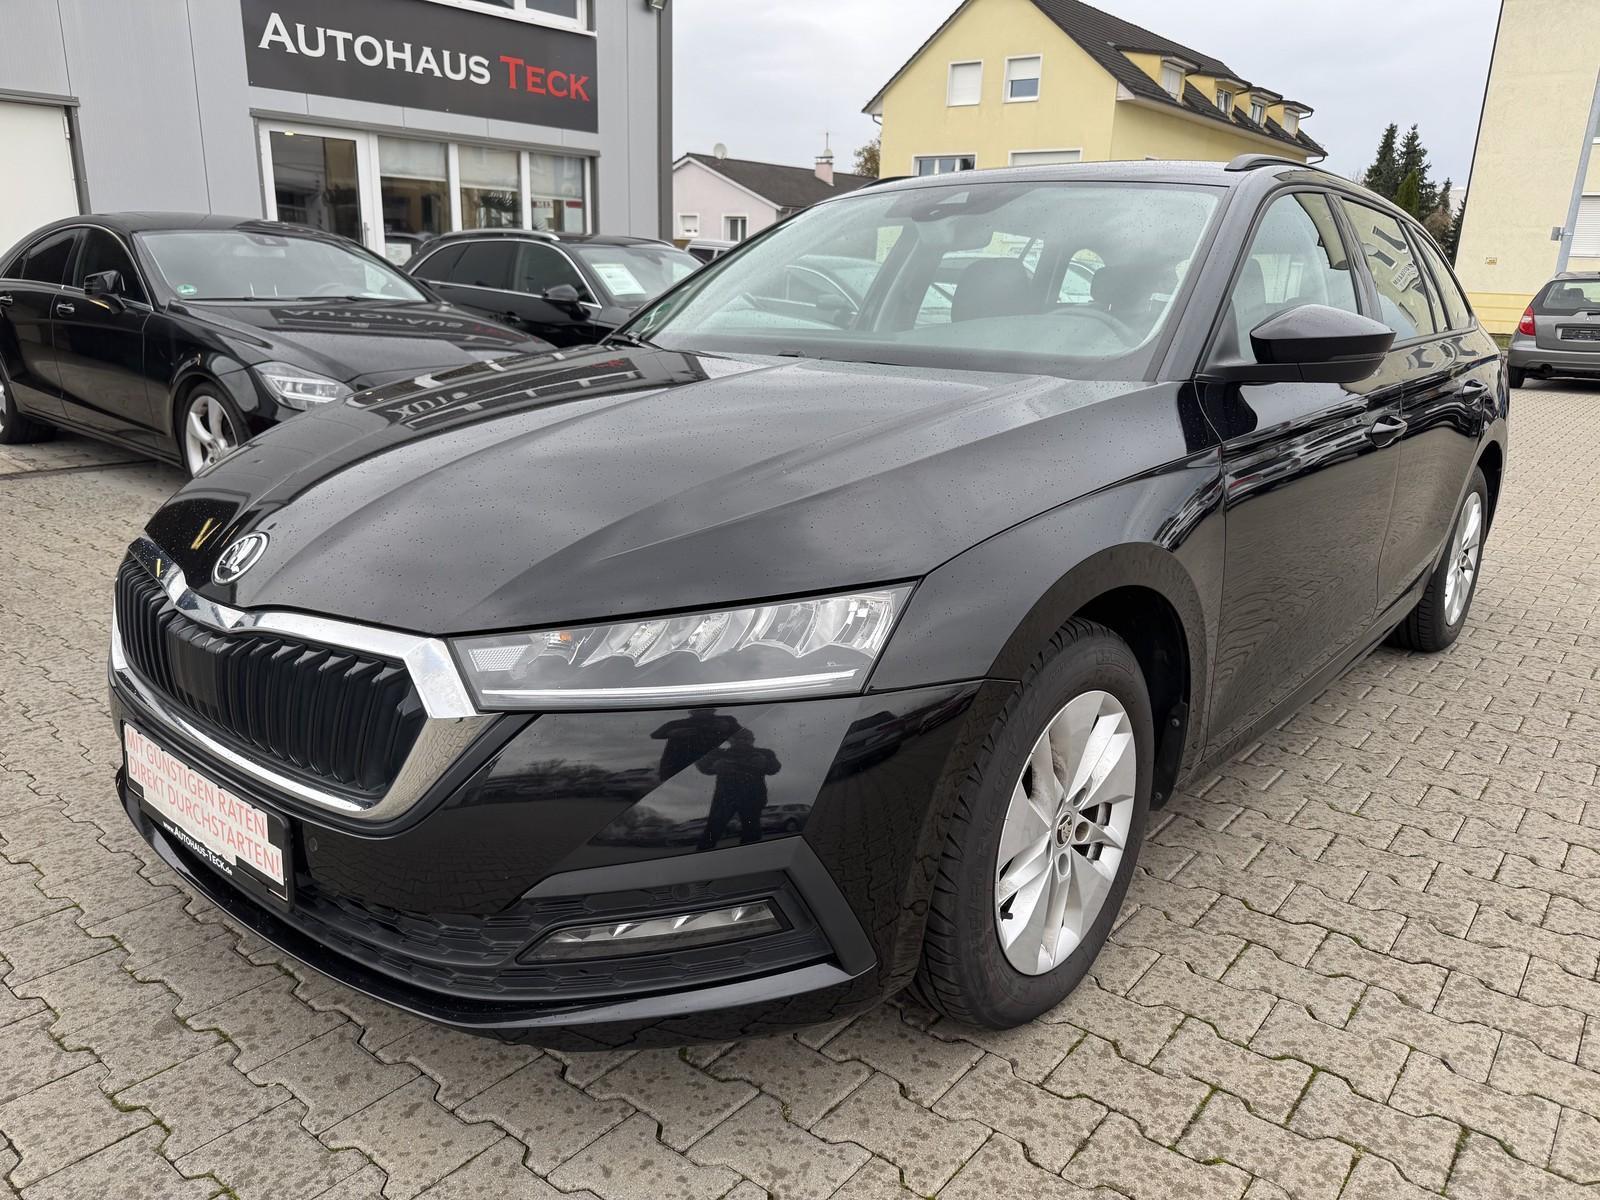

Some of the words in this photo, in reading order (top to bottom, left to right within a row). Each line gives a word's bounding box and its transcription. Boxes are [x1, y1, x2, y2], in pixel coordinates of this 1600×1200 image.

[258, 12, 491, 85] AUTOHAUS
[499, 55, 591, 102] TECK
[126, 727, 144, 757] MIT
[217, 791, 266, 840] RATEN
[129, 756, 166, 799] DIREKT
[167, 784, 281, 878] DURCHSTARTEN!
